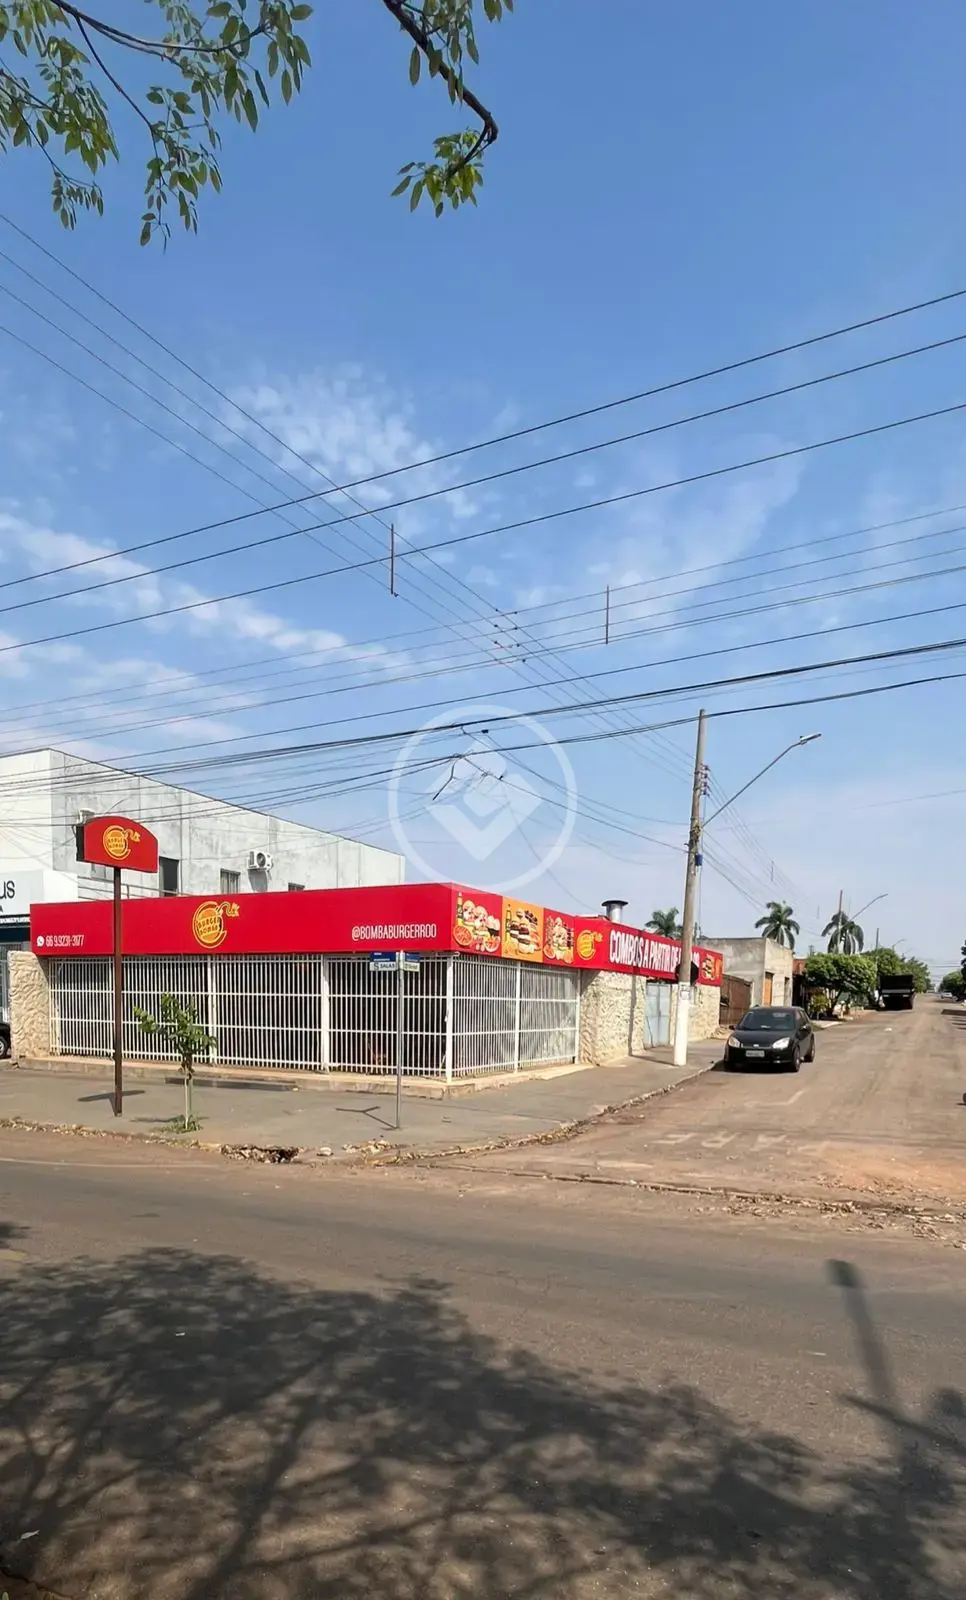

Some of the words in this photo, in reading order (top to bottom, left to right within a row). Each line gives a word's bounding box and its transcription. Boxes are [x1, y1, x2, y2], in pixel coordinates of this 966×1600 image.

[610, 930, 643, 966] COMBOS
[643, 939, 649, 968] A
[649, 941, 670, 971] PARTIR
[670, 946, 679, 973] DE
